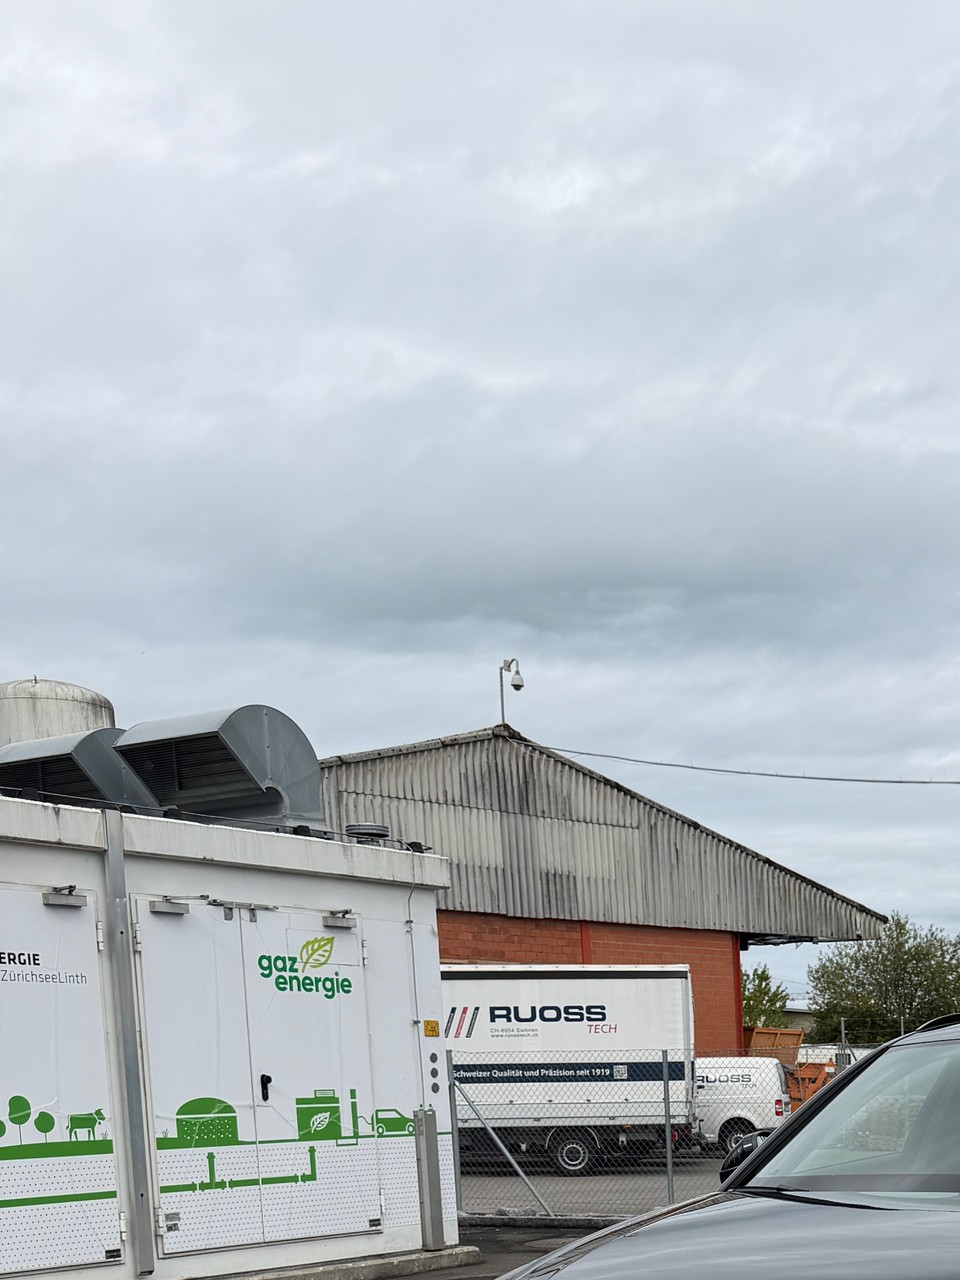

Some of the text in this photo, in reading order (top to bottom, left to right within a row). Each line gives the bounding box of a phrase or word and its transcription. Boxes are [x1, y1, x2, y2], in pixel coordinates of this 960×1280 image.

[257, 954, 299, 978] gaz
[0, 969, 87, 984] ZürichseeLinth
[274, 970, 352, 1000] energie
[489, 1005, 607, 1023] RUOSS
[587, 1024, 618, 1034] TECH
[491, 1069, 523, 1077] Qualität
[576, 1068, 590, 1076] seit
[591, 1068, 610, 1076] 1919
